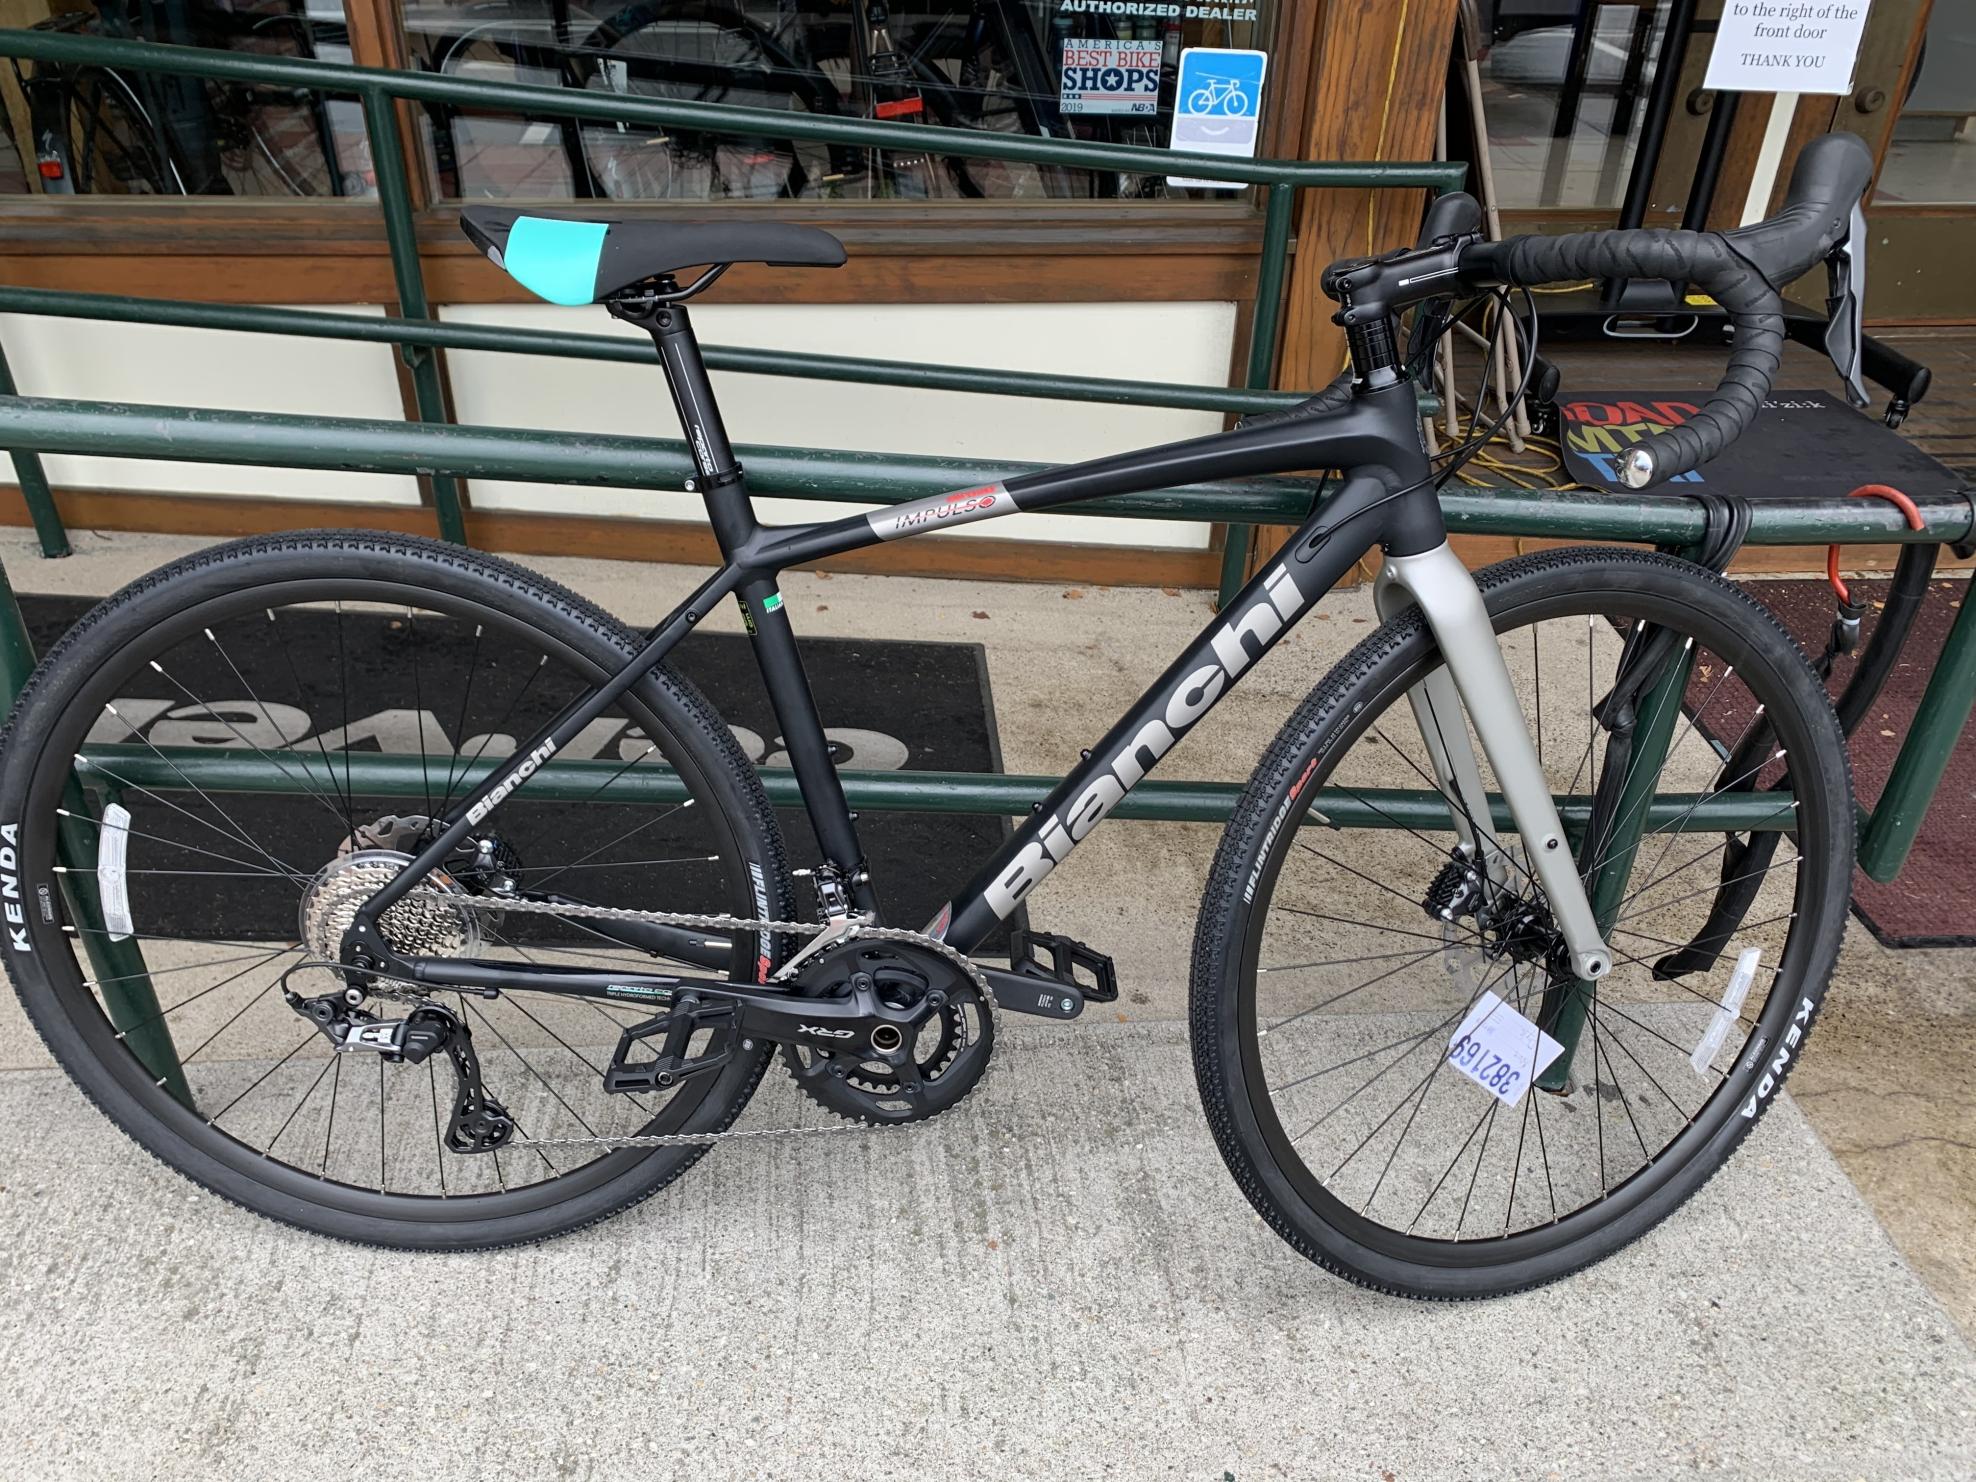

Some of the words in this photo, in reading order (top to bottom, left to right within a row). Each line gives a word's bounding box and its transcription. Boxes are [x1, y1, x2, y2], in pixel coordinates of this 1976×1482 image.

[1060, 0, 1180, 17] AUTHORIZED
[1185, 6, 1257, 21] DEALER
[1733, 2, 1749, 17] to
[1752, 2, 1776, 17] the
[1780, 3, 1813, 21] right
[1816, 4, 1834, 19] of
[1834, 6, 1858, 20] the
[1753, 23, 1791, 39] front
[1794, 24, 1827, 40] door
[1065, 39, 1162, 50] AMERICA'S
[1064, 50, 1112, 67] BEST
[1116, 51, 1160, 68] BIKE
[1740, 52, 1792, 68] THANK
[1796, 54, 1826, 68] YOU
[1063, 67, 1159, 92] SHOPS
[1061, 103, 1083, 112] 2019
[895, 495, 997, 529] IMPULSO
[983, 562, 1305, 921] Bianchi
[465, 736, 557, 827] Bianchi
[1246, 795, 1293, 890] FLINTRIDGE
[0, 822, 32, 952] KENDA
[797, 1023, 856, 1039] GRX
[1449, 1035, 1521, 1096] 382169
[1740, 996, 1815, 1119] KENDA
